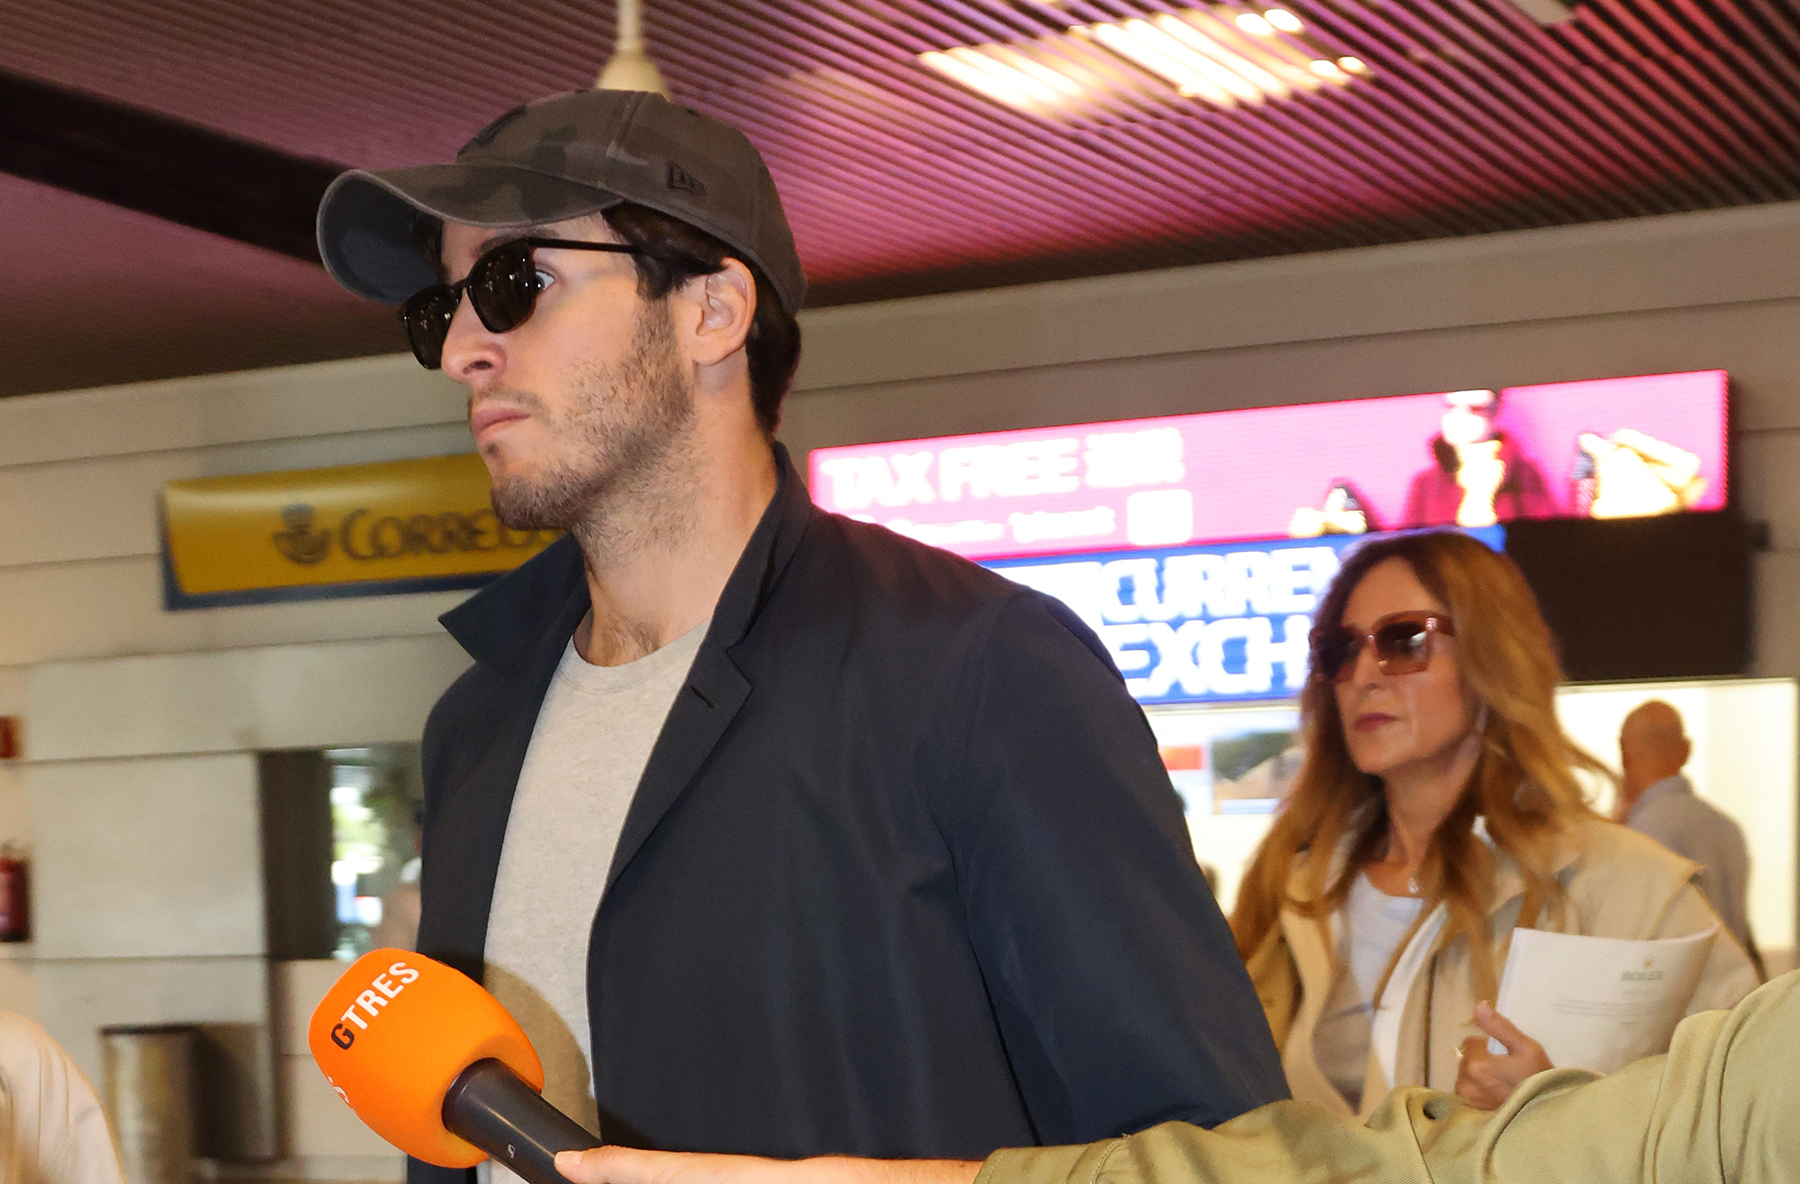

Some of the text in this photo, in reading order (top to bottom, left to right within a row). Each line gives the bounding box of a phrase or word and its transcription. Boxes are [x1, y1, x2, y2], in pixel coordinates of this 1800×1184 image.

[820, 450, 936, 511] TAX
[938, 436, 1081, 502] FREE
[340, 507, 565, 562] CORREO
[1100, 546, 1340, 623] CURRE
[330, 961, 420, 1051] GTRES
